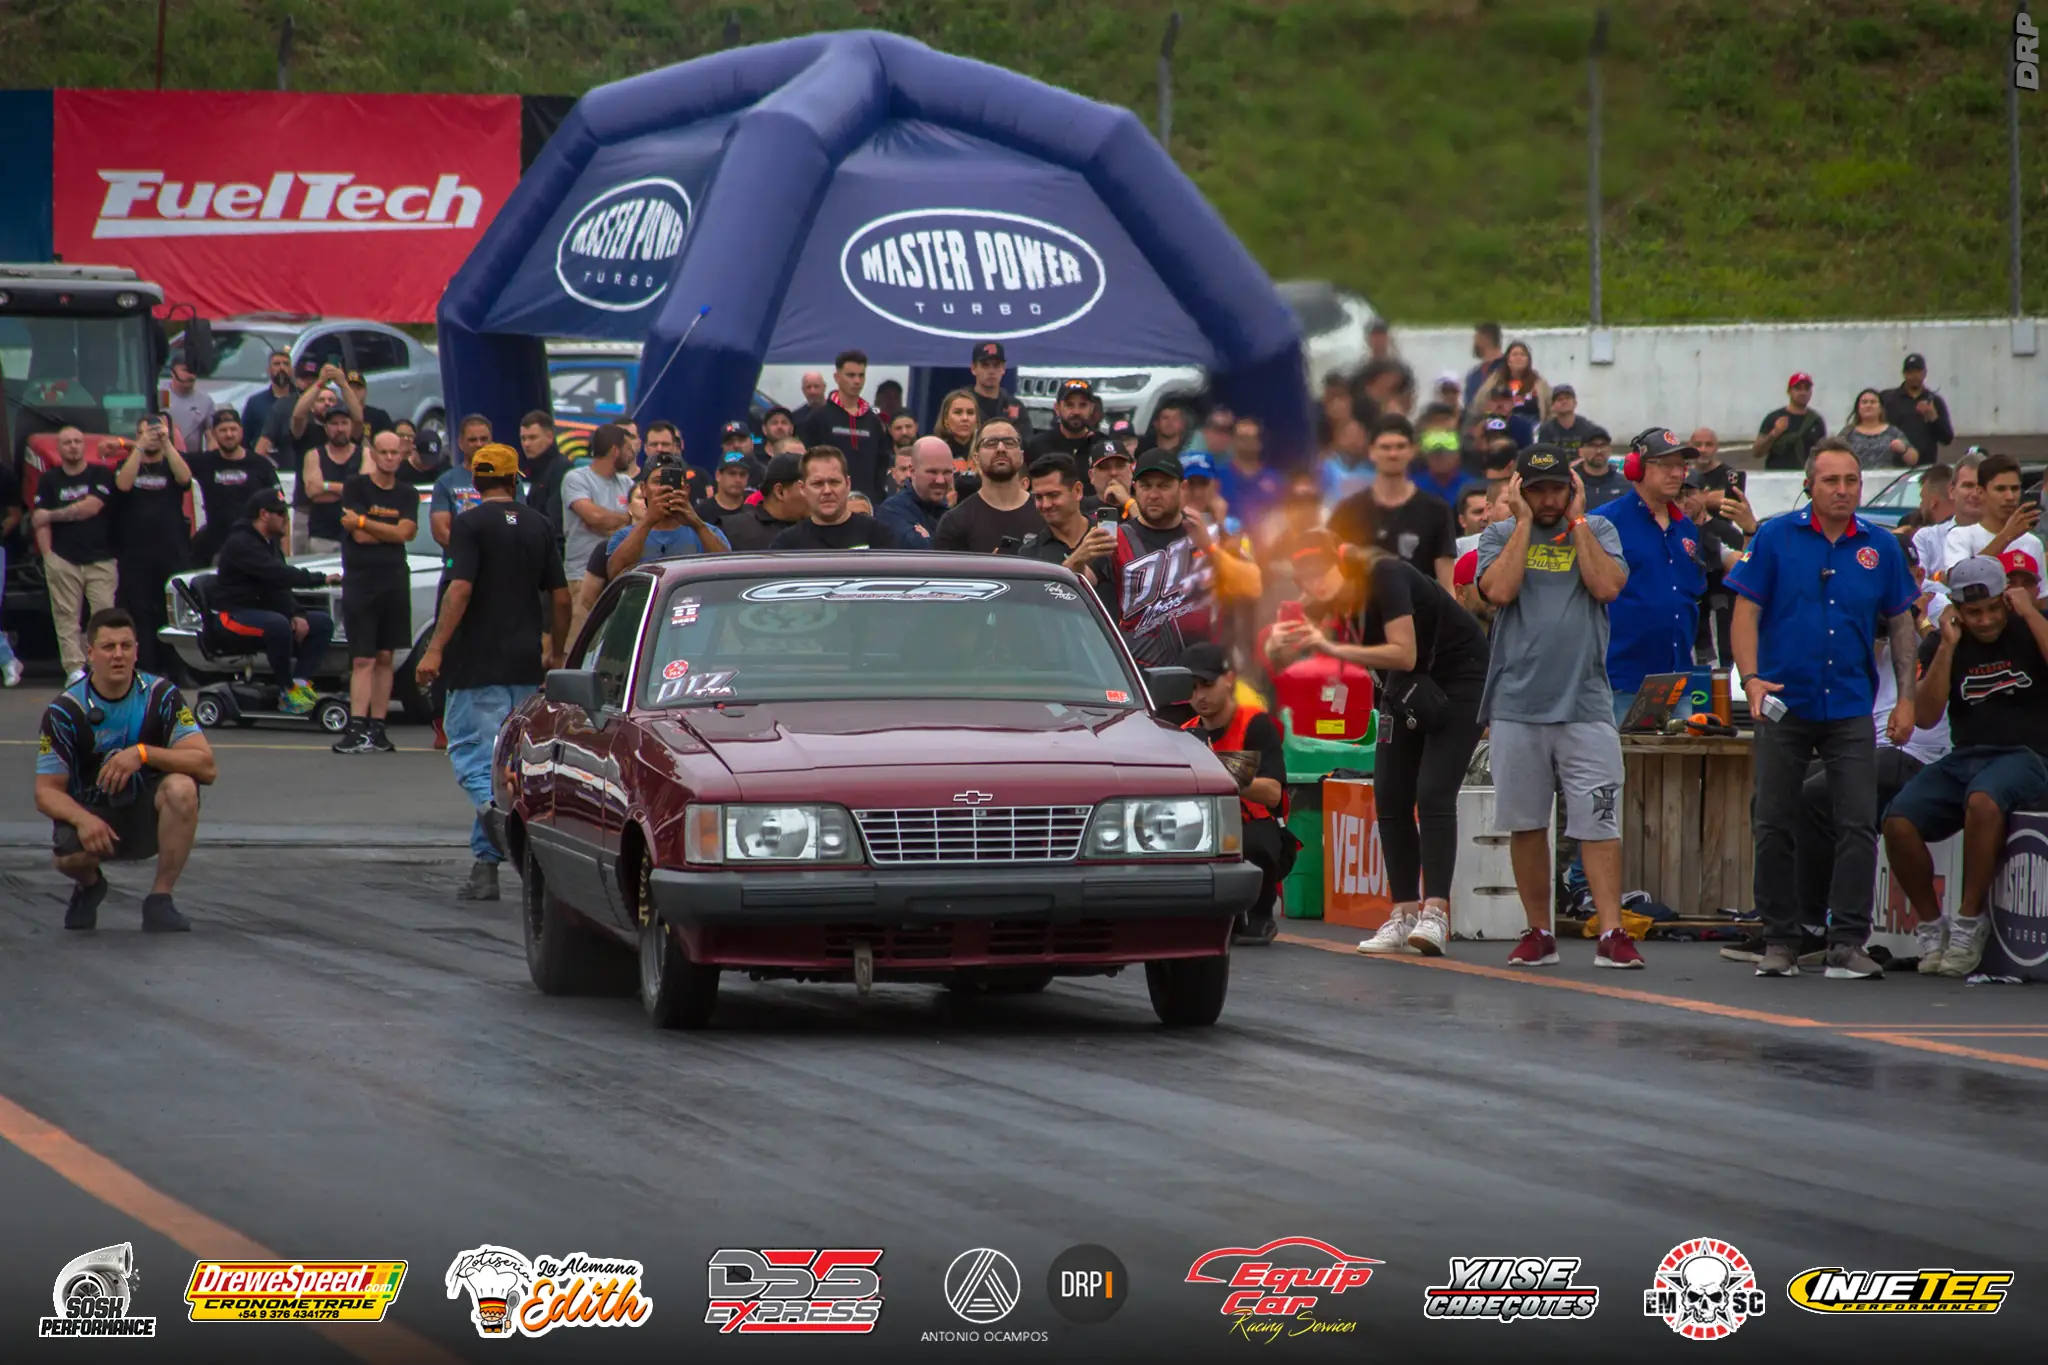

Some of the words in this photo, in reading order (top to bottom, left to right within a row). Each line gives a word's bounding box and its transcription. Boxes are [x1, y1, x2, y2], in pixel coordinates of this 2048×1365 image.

[95, 169, 484, 229] FuelTech
[570, 198, 646, 260] MASTER
[630, 198, 684, 262] POWER
[583, 271, 654, 288] TURBO
[860, 229, 975, 291] MASTER
[973, 229, 1084, 291] POWER
[914, 302, 1042, 316] TURBO
[2007, 926, 2047, 945] TURBO
